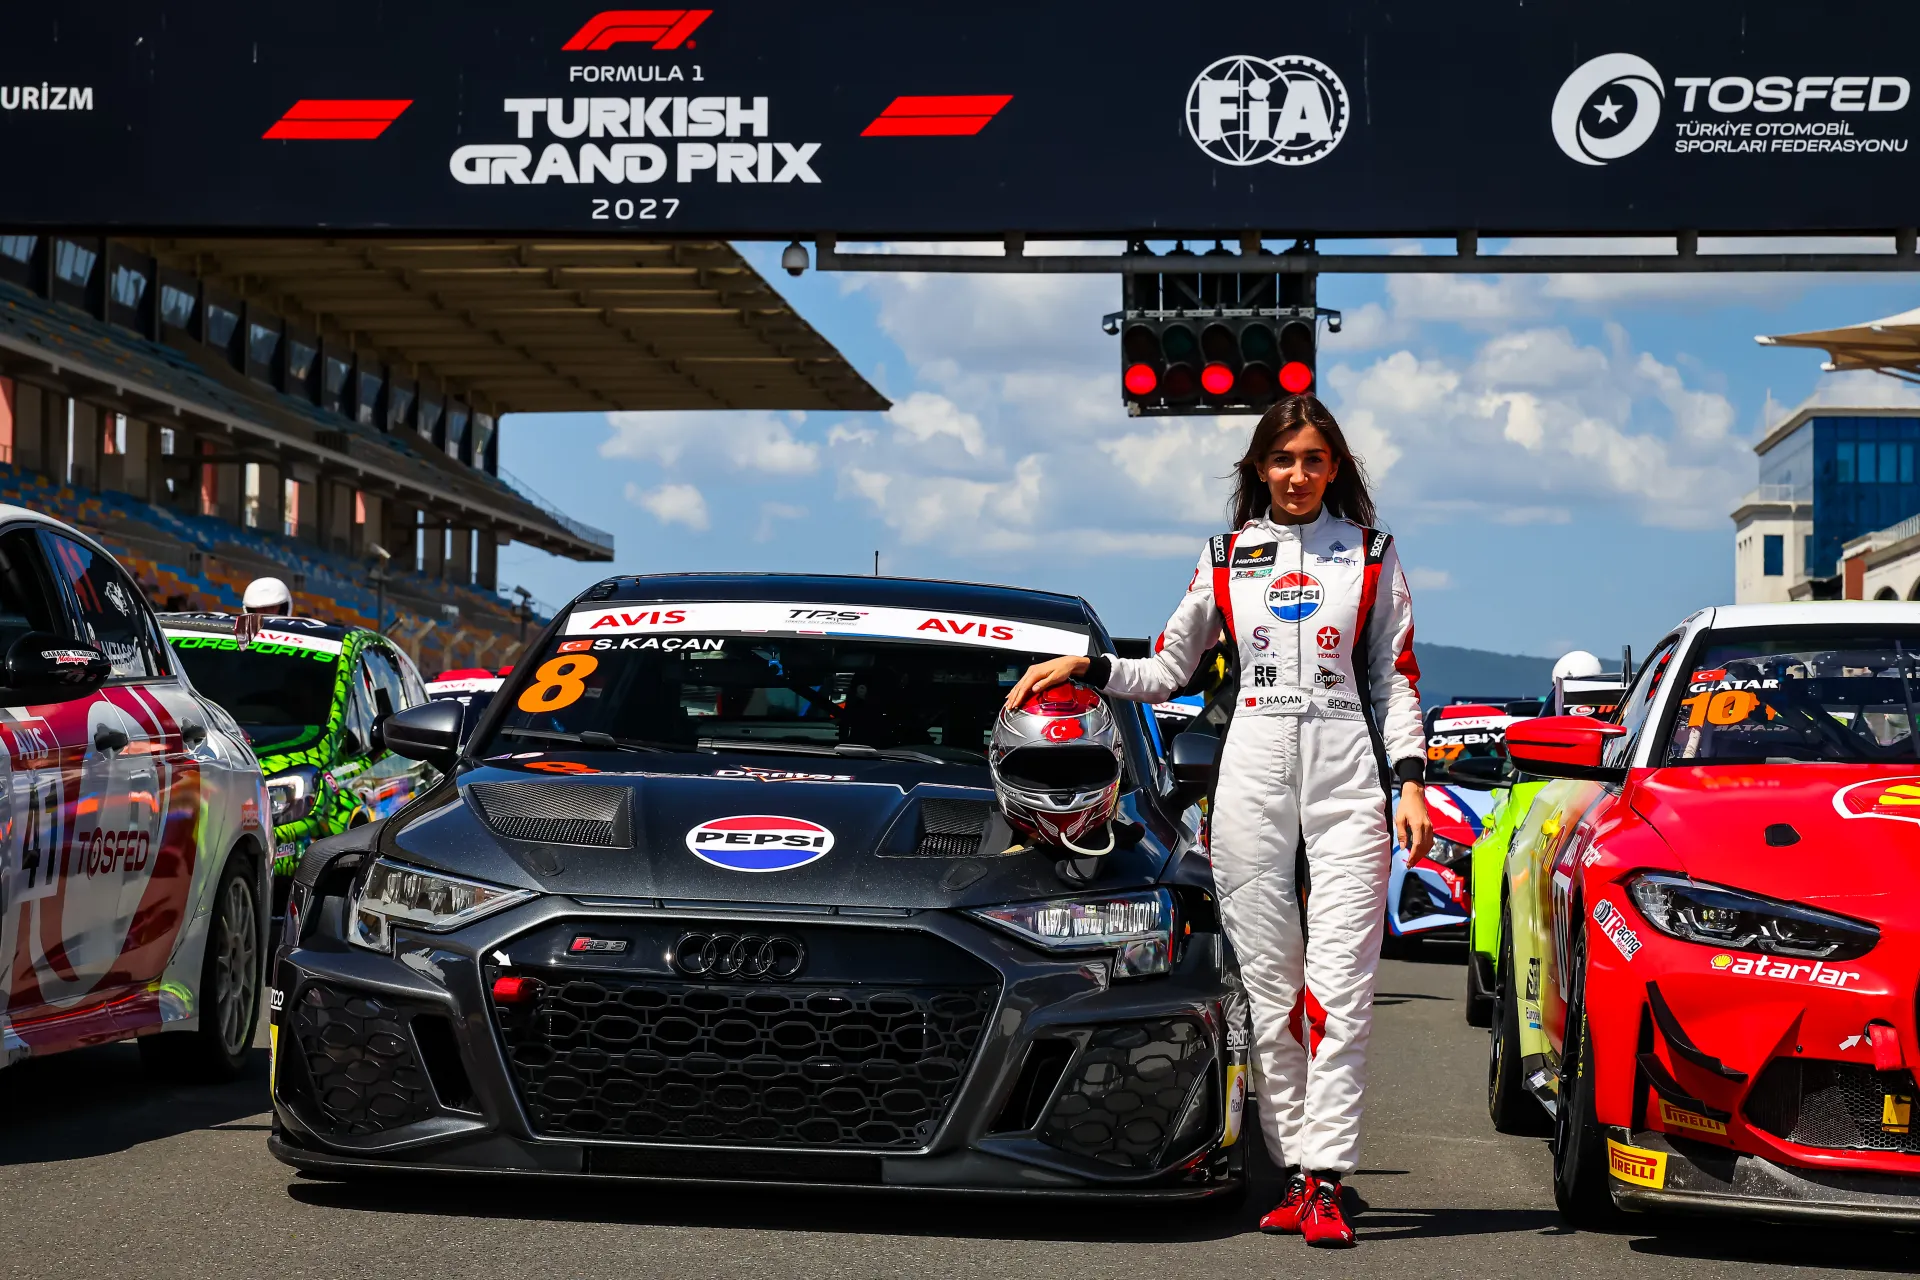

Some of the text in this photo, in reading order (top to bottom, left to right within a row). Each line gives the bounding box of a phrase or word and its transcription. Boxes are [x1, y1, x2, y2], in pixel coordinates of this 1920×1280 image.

[570, 65, 704, 82] FORMULA 1
[1674, 76, 1911, 113] TOSFED
[504, 97, 768, 138] TURKISH
[1675, 120, 1854, 136] TÜRKİYE OTOMOBİL
[1674, 139, 1909, 153] SPORLARI FEDERASYONU
[449, 143, 822, 184] GRAND PRIX
[592, 198, 680, 219] 2027
[1269, 589, 1320, 602] PEPSI
[589, 610, 687, 629] AVIS
[916, 618, 1014, 640] AVIS
[593, 638, 725, 652] S.KAÇAN
[1255, 666, 1277, 677] RE
[1315, 673, 1345, 684] Doritos
[517, 654, 599, 713] 8
[1255, 677, 1277, 687] MY
[1690, 679, 1779, 692] G.ATAR
[1258, 696, 1302, 706] S.KAÇAN
[1327, 698, 1361, 711] sparco
[1681, 690, 1751, 727] 10
[1427, 744, 1466, 761] 67
[716, 769, 856, 781] Doritos
[695, 831, 825, 848] PEPSI
[77, 826, 150, 880] TOSFED
[1731, 954, 1861, 987] atarlar
[1664, 1103, 1721, 1130] PIRELLI
[1610, 1146, 1658, 1181] PIRELLI
